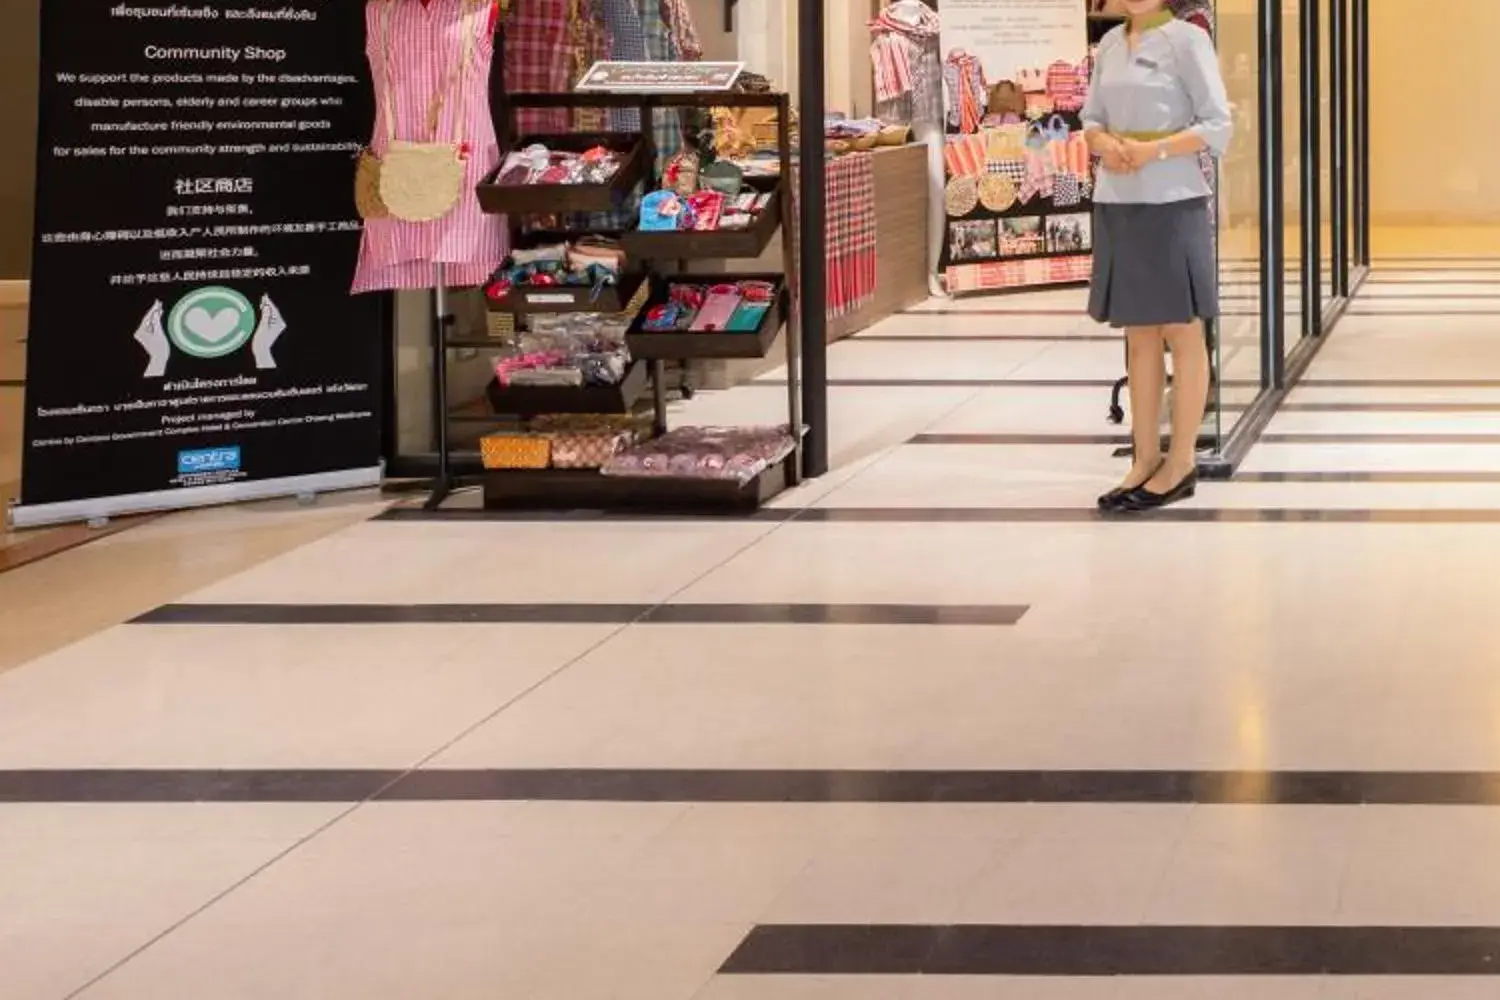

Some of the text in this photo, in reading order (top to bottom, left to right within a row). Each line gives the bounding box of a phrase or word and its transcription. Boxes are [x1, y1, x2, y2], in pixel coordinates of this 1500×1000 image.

[144, 45, 287, 63] Community Shop
[56, 72, 77, 84] We
[78, 72, 127, 85] support
[129, 72, 150, 84] the
[152, 72, 203, 85] products
[205, 73, 239, 84] made
[241, 73, 255, 85] by
[257, 73, 276, 84] the
[176, 96, 215, 109] elderly
[217, 96, 240, 107] and
[280, 96, 318, 109] groups
[91, 121, 168, 132] manufacture
[170, 120, 213, 132] friendly
[215, 119, 297, 130] environmental
[53, 146, 71, 157] for
[109, 145, 127, 156] for
[129, 145, 150, 156] the
[151, 143, 216, 156] community
[218, 142, 266, 155] strength
[267, 142, 289, 153] and
[174, 177, 253, 195] 社区商店
[161, 409, 256, 426] Project managed by
